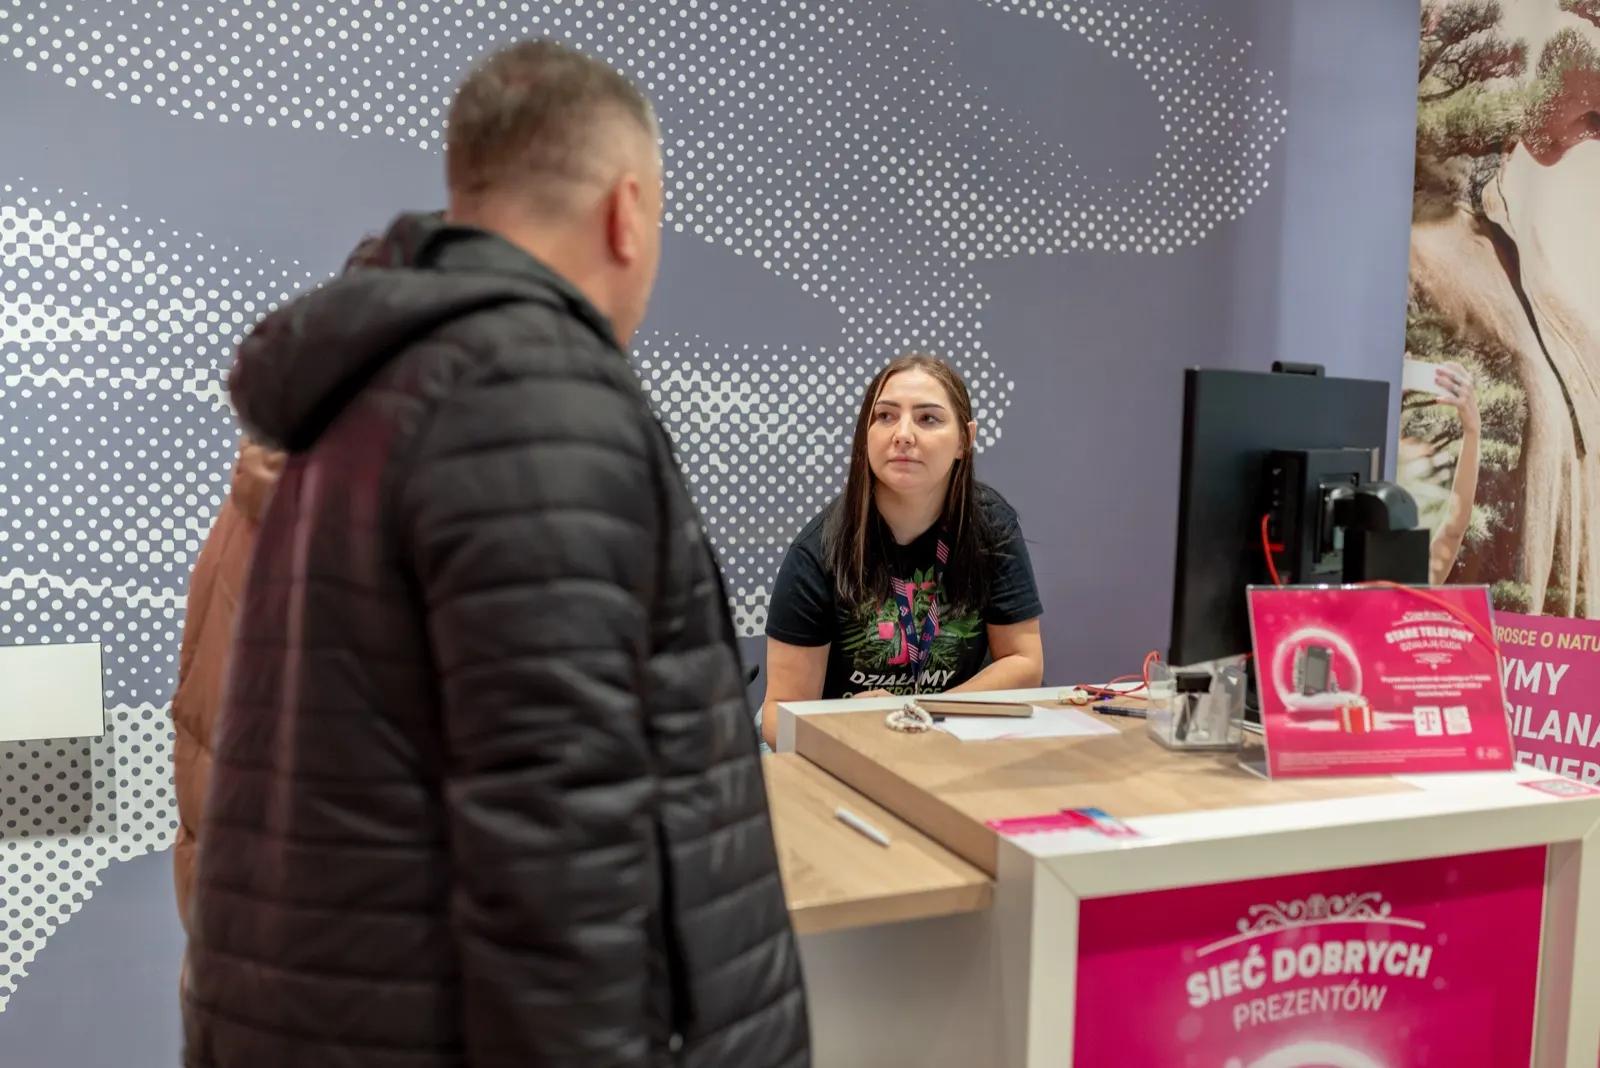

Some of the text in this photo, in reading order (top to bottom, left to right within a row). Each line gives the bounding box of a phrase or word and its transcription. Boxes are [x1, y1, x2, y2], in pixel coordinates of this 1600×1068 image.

[1494, 625, 1537, 647] ROSCE
[1540, 631, 1553, 648] O
[1186, 940, 1433, 1009] SIEĆ DOBRYCH
[1232, 978, 1388, 1032] PREZENTÓW
